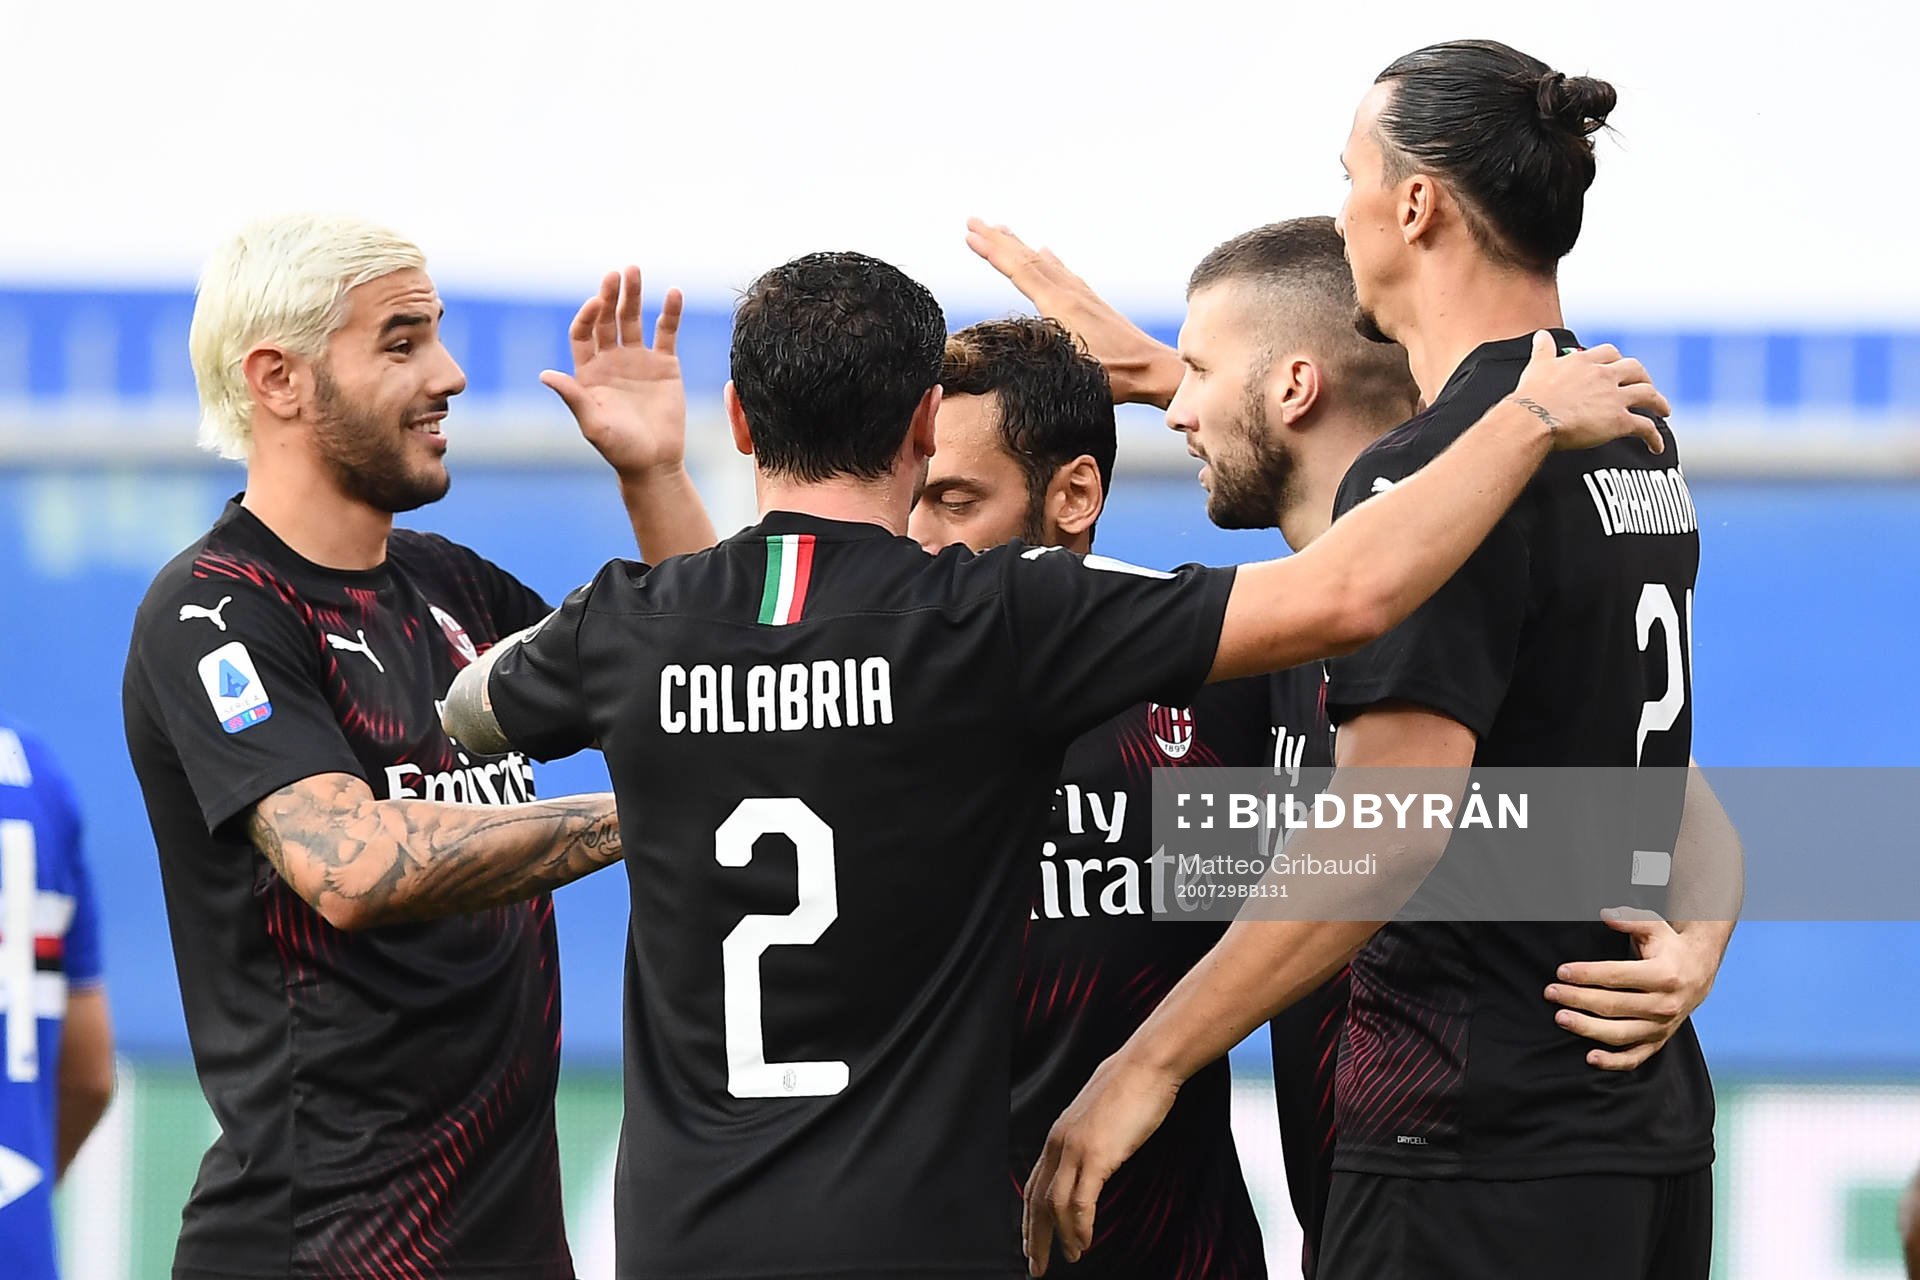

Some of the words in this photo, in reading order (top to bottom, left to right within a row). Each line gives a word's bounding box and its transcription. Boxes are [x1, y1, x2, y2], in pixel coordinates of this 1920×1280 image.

[660, 656, 893, 734] CALABRIA
[1164, 743, 1187, 753] 1899
[1271, 726, 1307, 788] ly
[1052, 784, 1128, 843] ly
[714, 797, 850, 1099] 2
